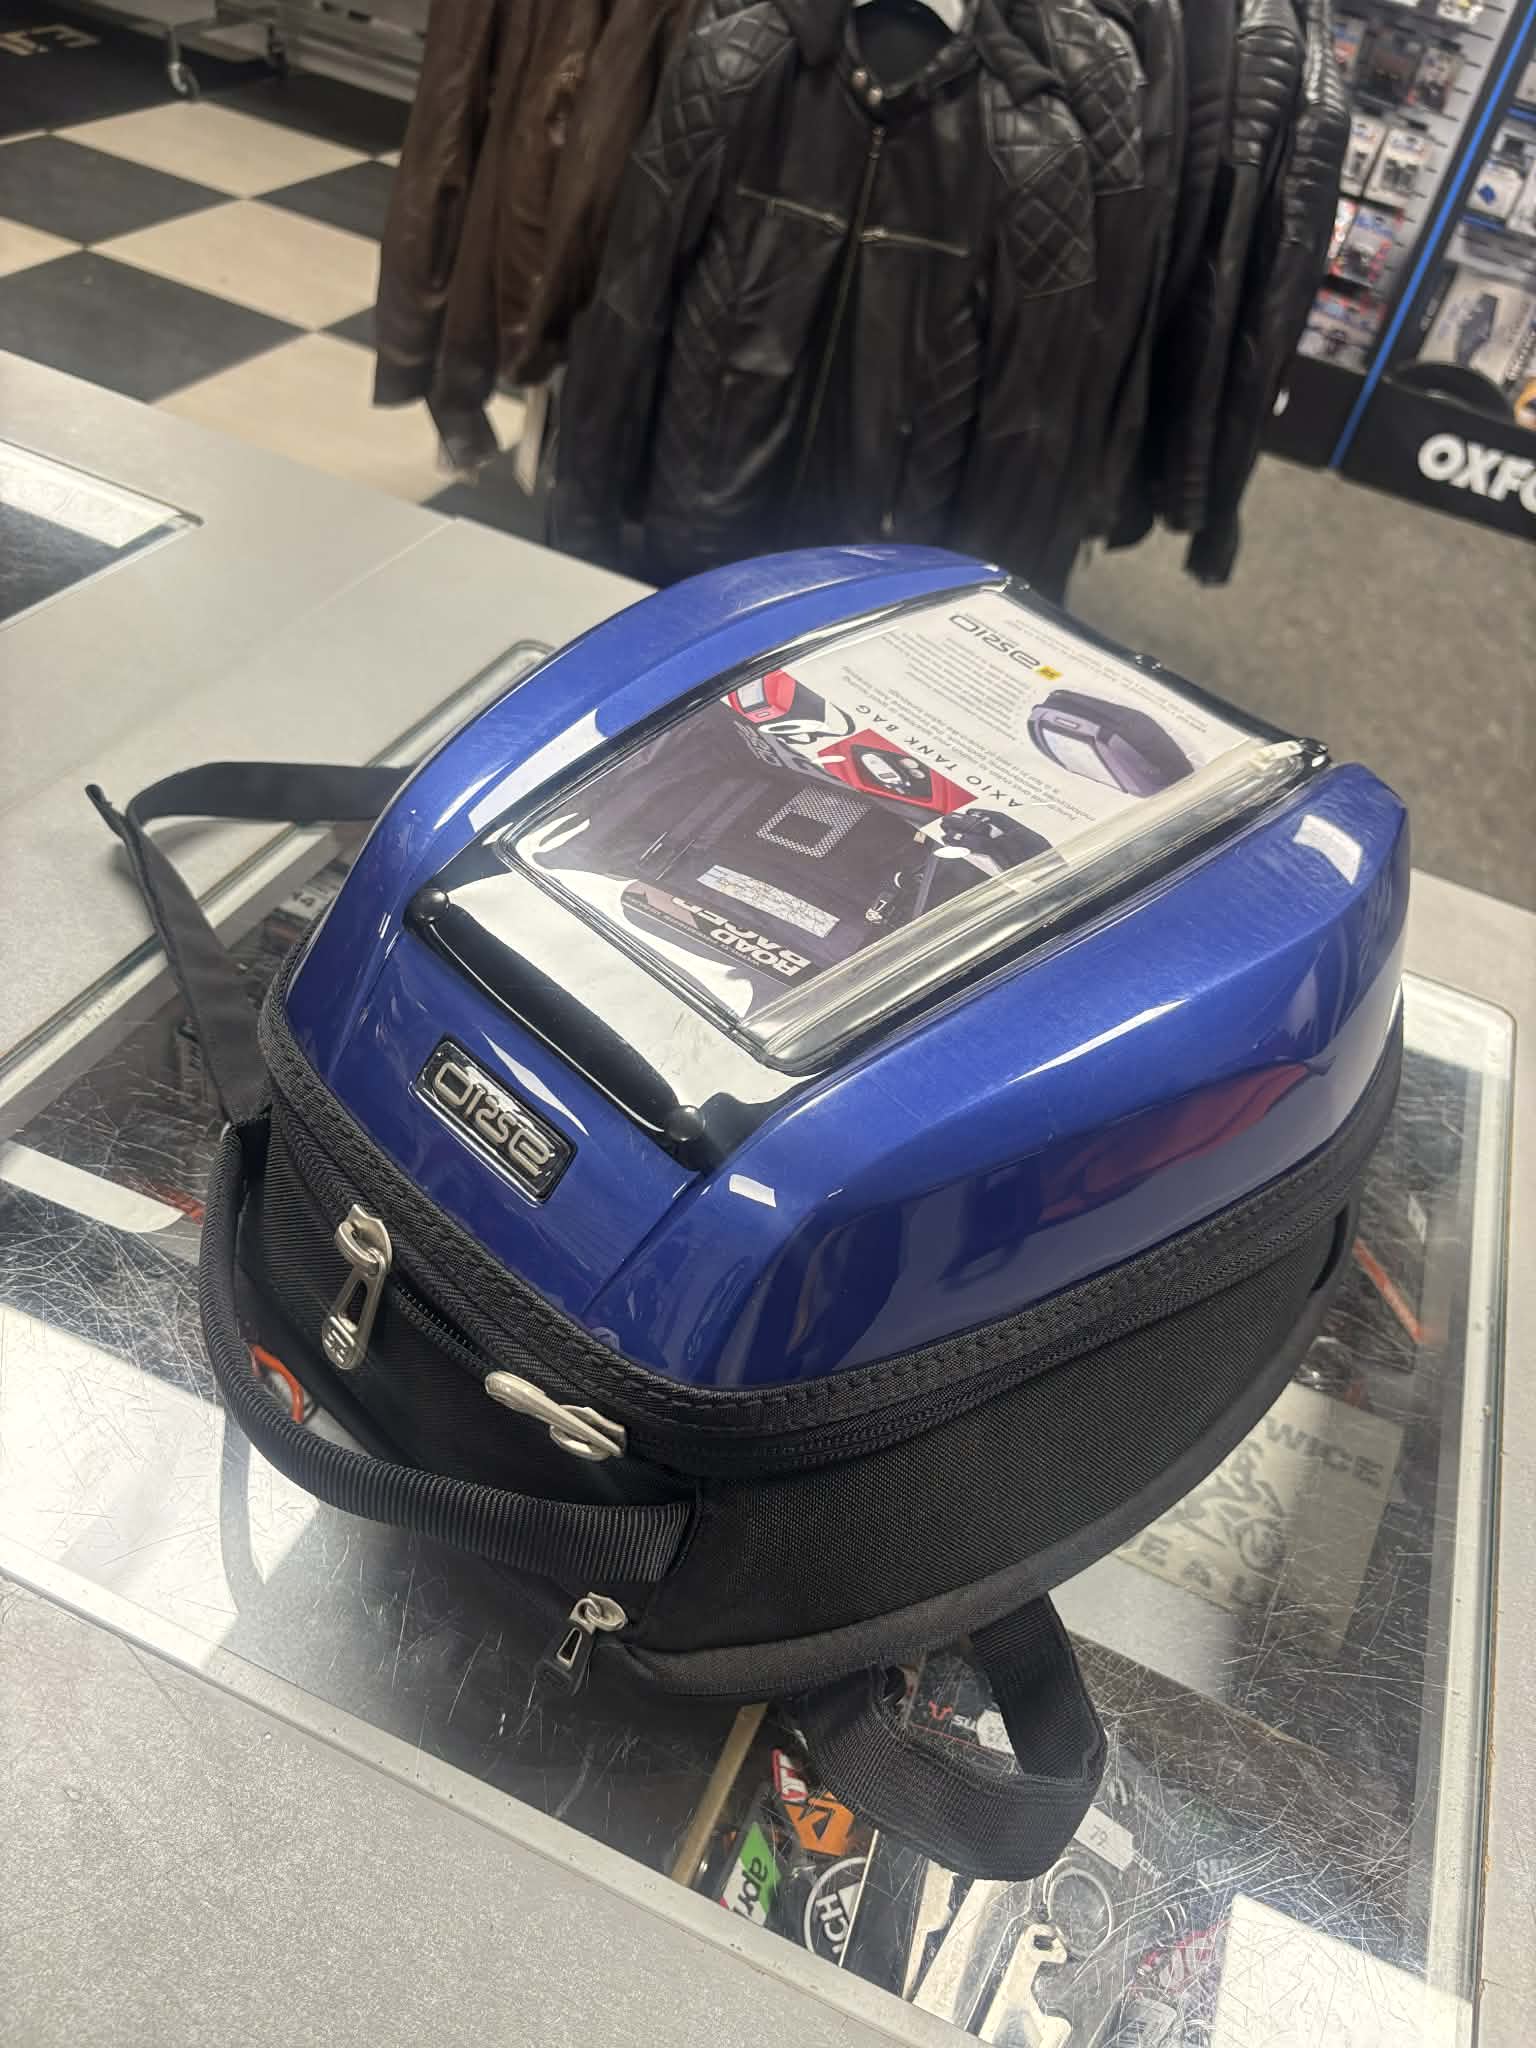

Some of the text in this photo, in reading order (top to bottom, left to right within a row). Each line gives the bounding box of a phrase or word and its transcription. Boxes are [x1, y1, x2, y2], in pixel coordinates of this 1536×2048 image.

[856, 704, 899, 732] BAG
[904, 736, 958, 771] TANK
[966, 775, 1025, 808] AXIO
[710, 928, 800, 976] ROAD
